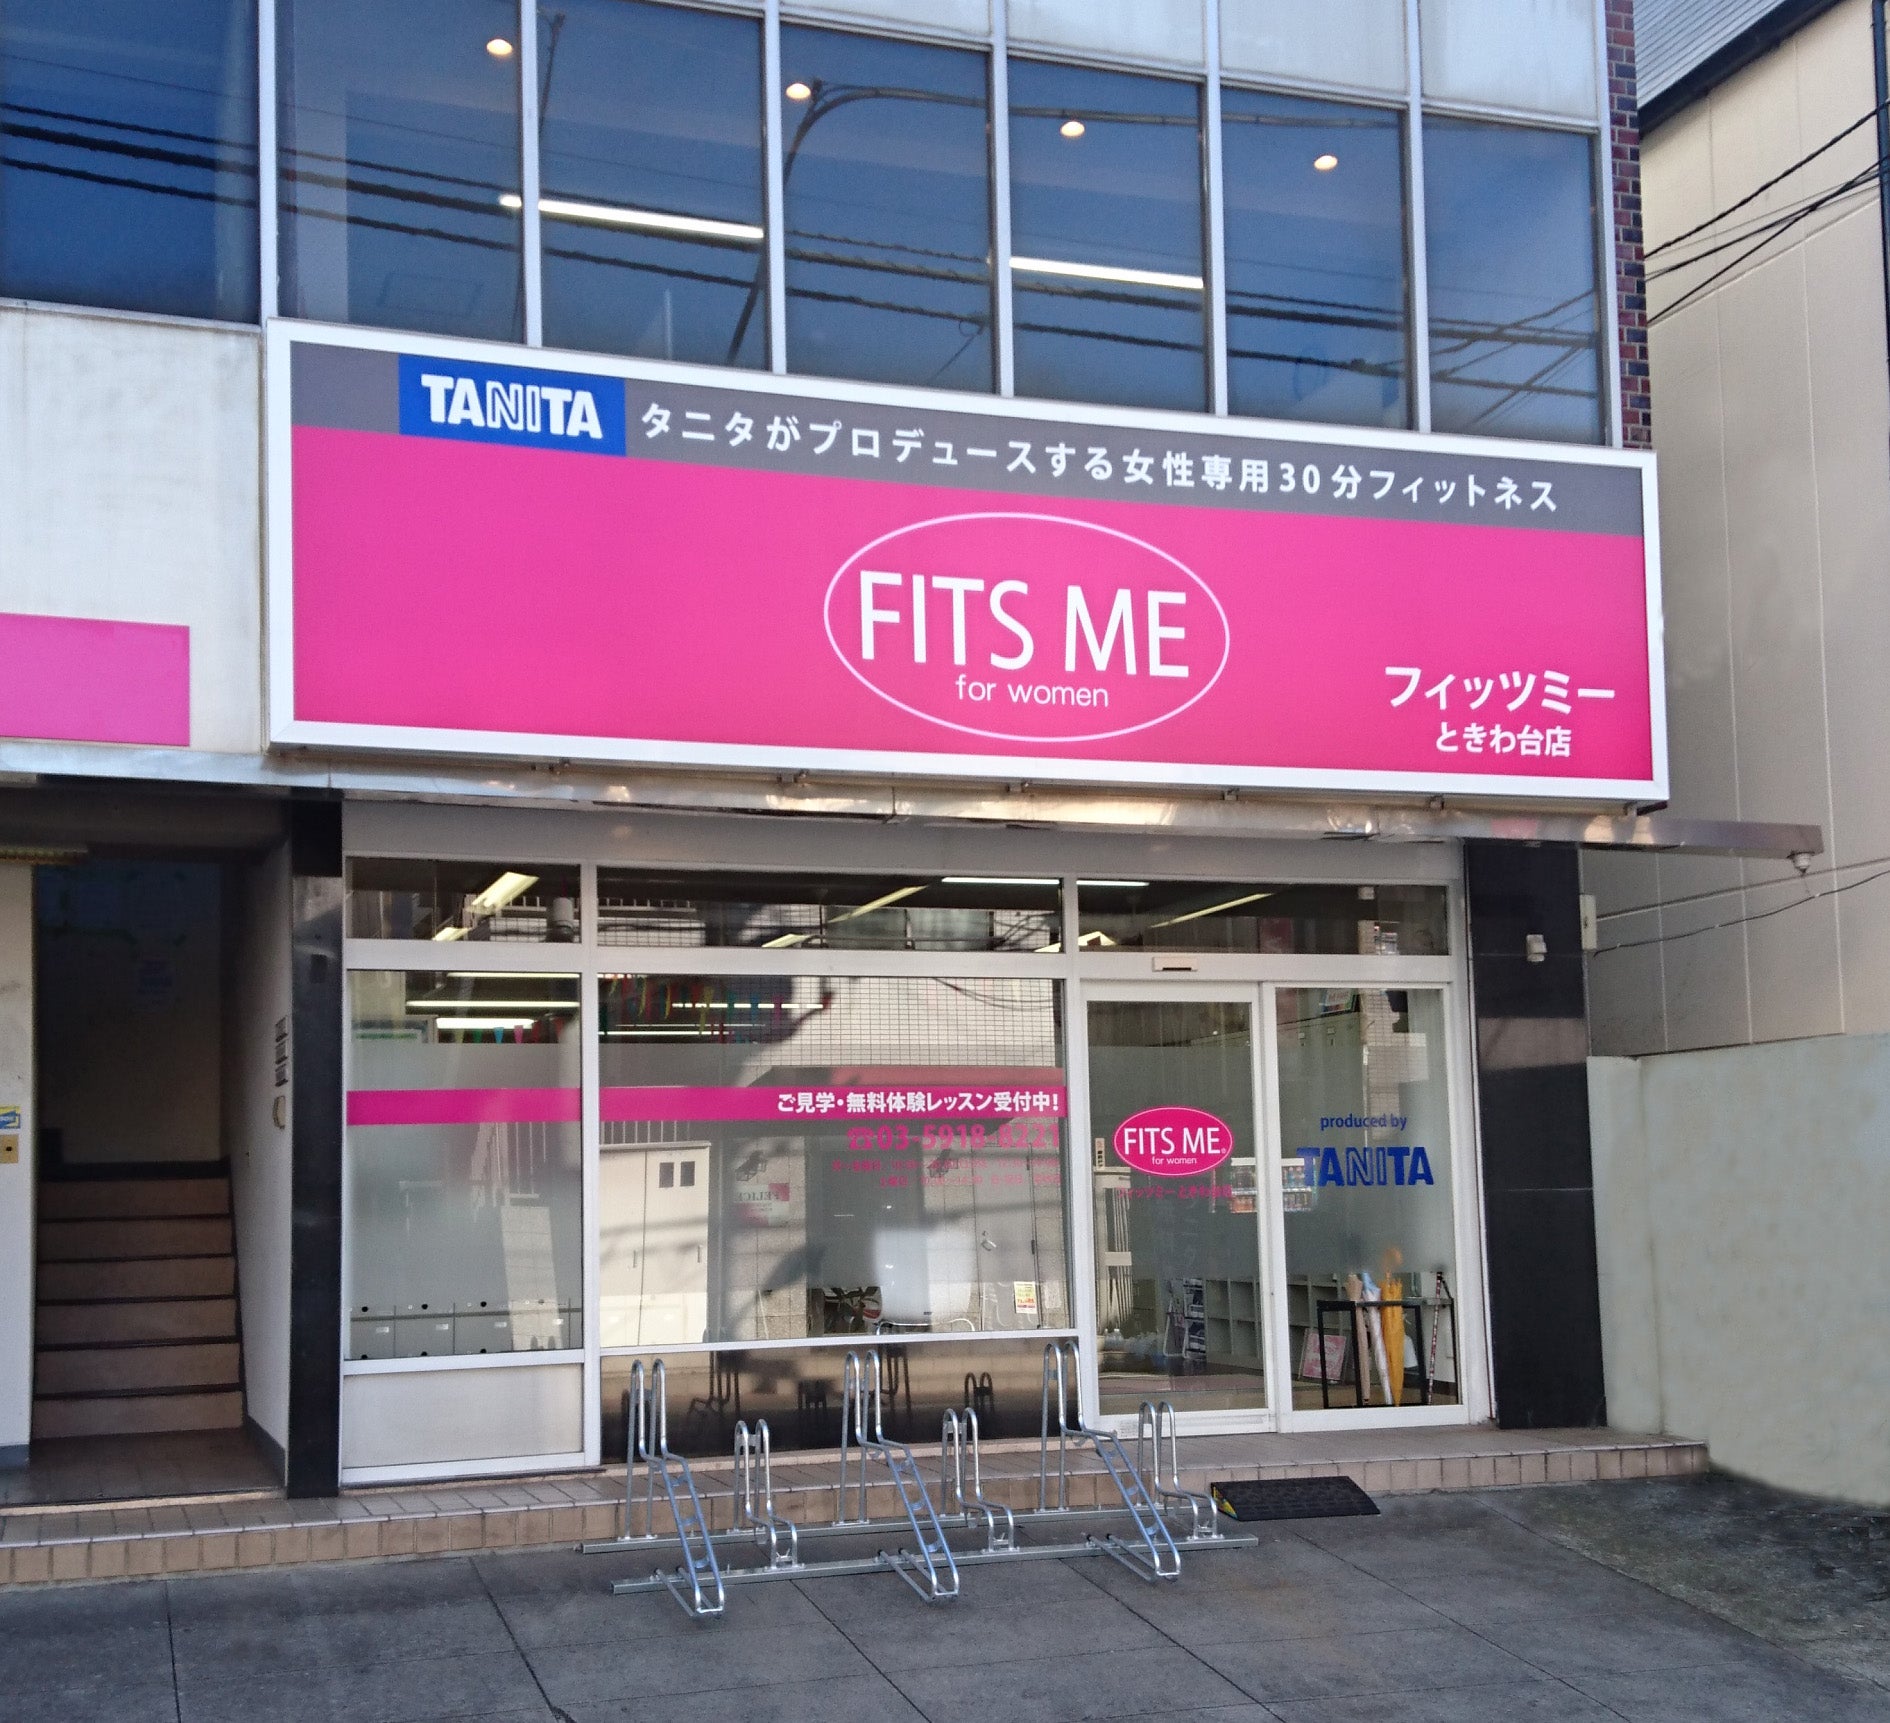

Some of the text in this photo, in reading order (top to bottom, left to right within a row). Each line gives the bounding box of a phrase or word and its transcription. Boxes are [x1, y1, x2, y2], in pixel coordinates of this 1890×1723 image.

[421, 374, 602, 439] TANITA
[641, 403, 1558, 512] タニタがプロデュースする女性専用30分フィットネス
[859, 569, 1190, 679] FITS ME
[956, 674, 1109, 708] for women
[1384, 665, 1615, 714] フィッツミー
[1435, 721, 1572, 758] ときわ台店
[877, 1123, 1059, 1150] 03-5918-8221
[1320, 1113, 1407, 1131] produced by
[1124, 1127, 1221, 1155] FITS ME
[1151, 1155, 1197, 1165] for women
[1296, 1146, 1434, 1187] TANITA
